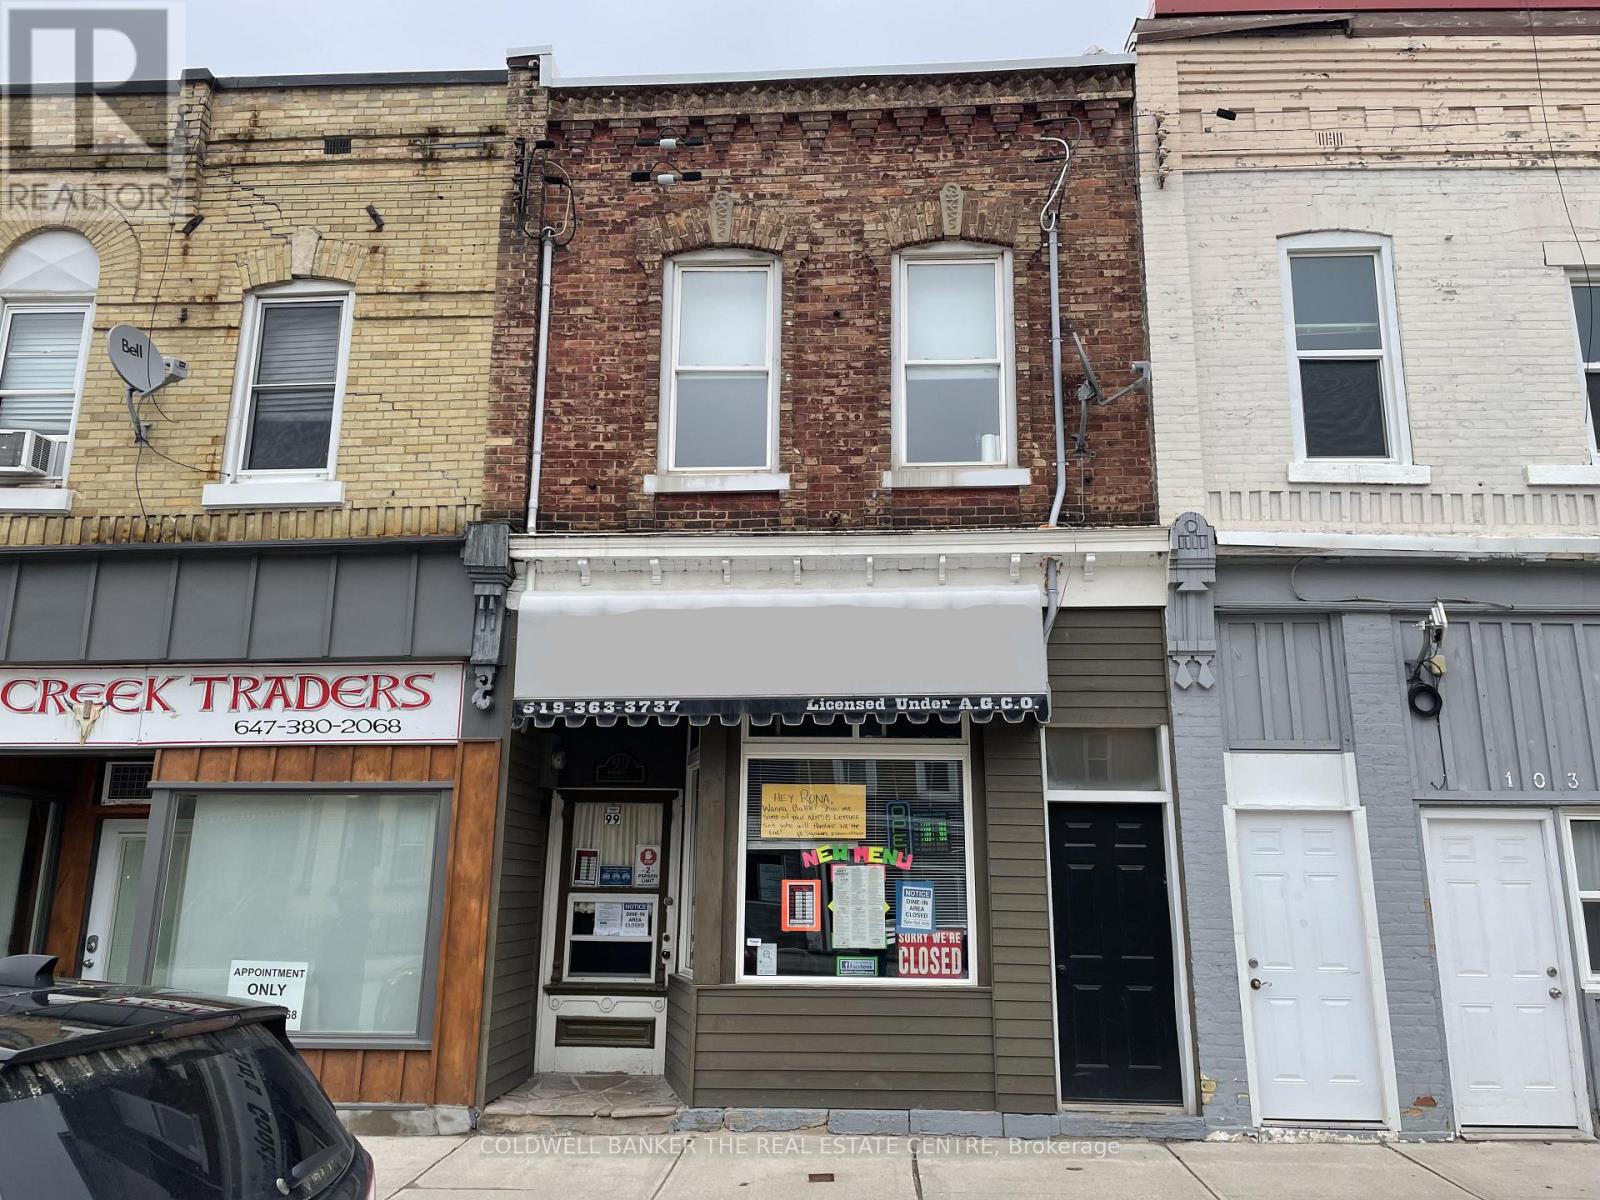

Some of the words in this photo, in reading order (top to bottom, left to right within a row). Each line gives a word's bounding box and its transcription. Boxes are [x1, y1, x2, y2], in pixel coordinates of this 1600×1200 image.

[122, 338, 142, 358] Bell
[0, 675, 183, 713] CREEK
[189, 672, 436, 712] TRADERS
[522, 700, 680, 714] 519-363-3737
[806, 697, 886, 710] Licensed
[895, 697, 950, 710] Under
[958, 696, 1039, 710] A.G.C.O.
[234, 718, 402, 735] 647-380-2068
[774, 792, 794, 803] HEY
[606, 814, 620, 824] 99
[802, 844, 848, 868] NEW
[854, 846, 913, 870] MENU
[904, 890, 930, 898] NOTICE
[898, 932, 928, 944] SORRY
[932, 932, 960, 944] WE'RE
[898, 946, 962, 975] CLOSED
[234, 968, 306, 978] APPOINTMENT
[247, 983, 287, 997] ONLY
